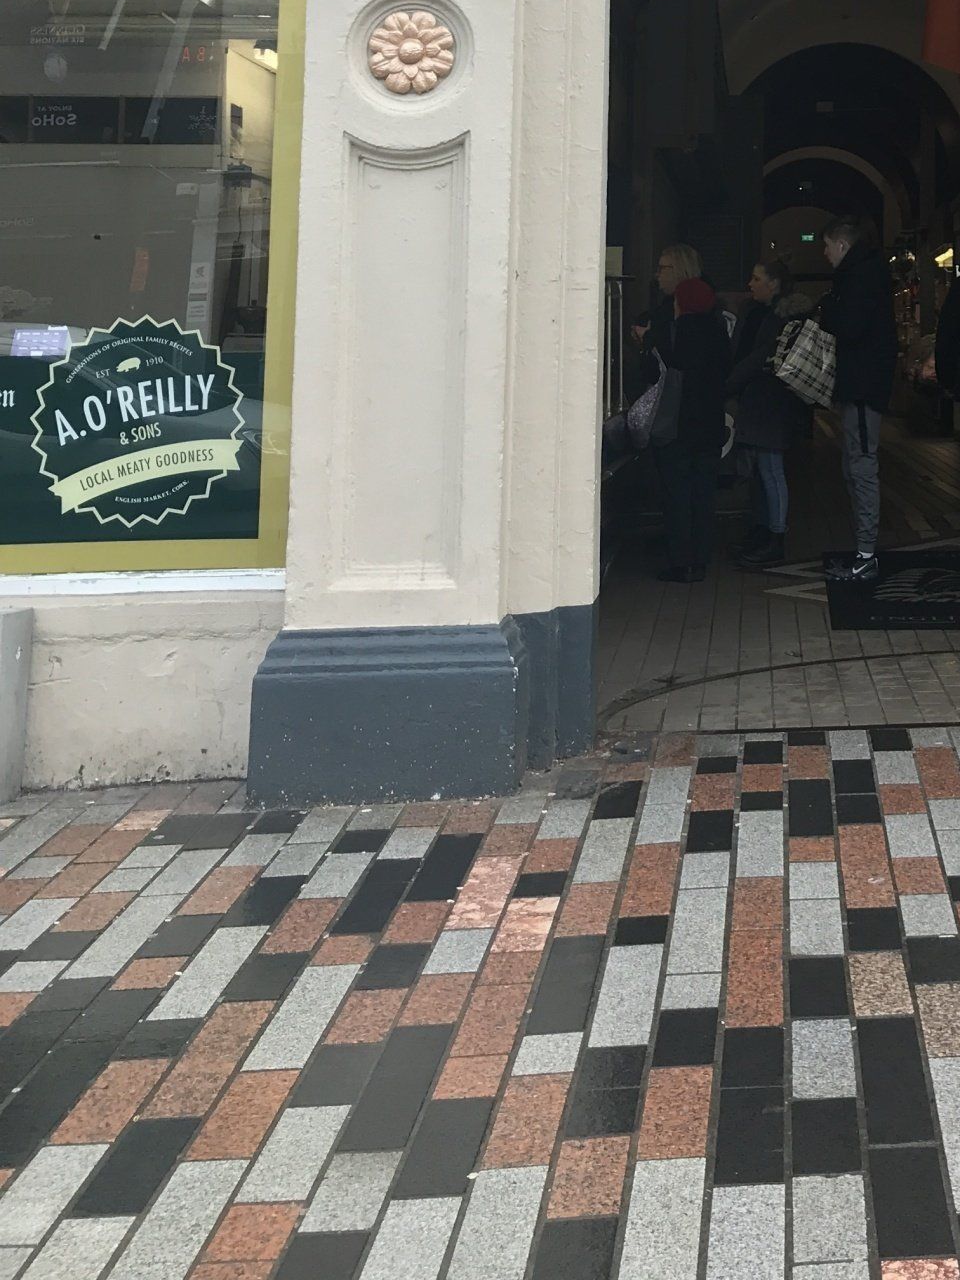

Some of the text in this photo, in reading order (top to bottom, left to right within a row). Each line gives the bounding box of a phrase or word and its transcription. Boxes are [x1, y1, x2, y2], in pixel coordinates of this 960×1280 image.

[65, 336, 193, 384] GENERATIONS OF ORIGINAL FAMILY RECIPES
[95, 356, 164, 379] EST 1910
[0, 389, 16, 408] n
[119, 422, 162, 445] & SONS
[79, 448, 214, 491] LOCAL MEATY GOODNESS
